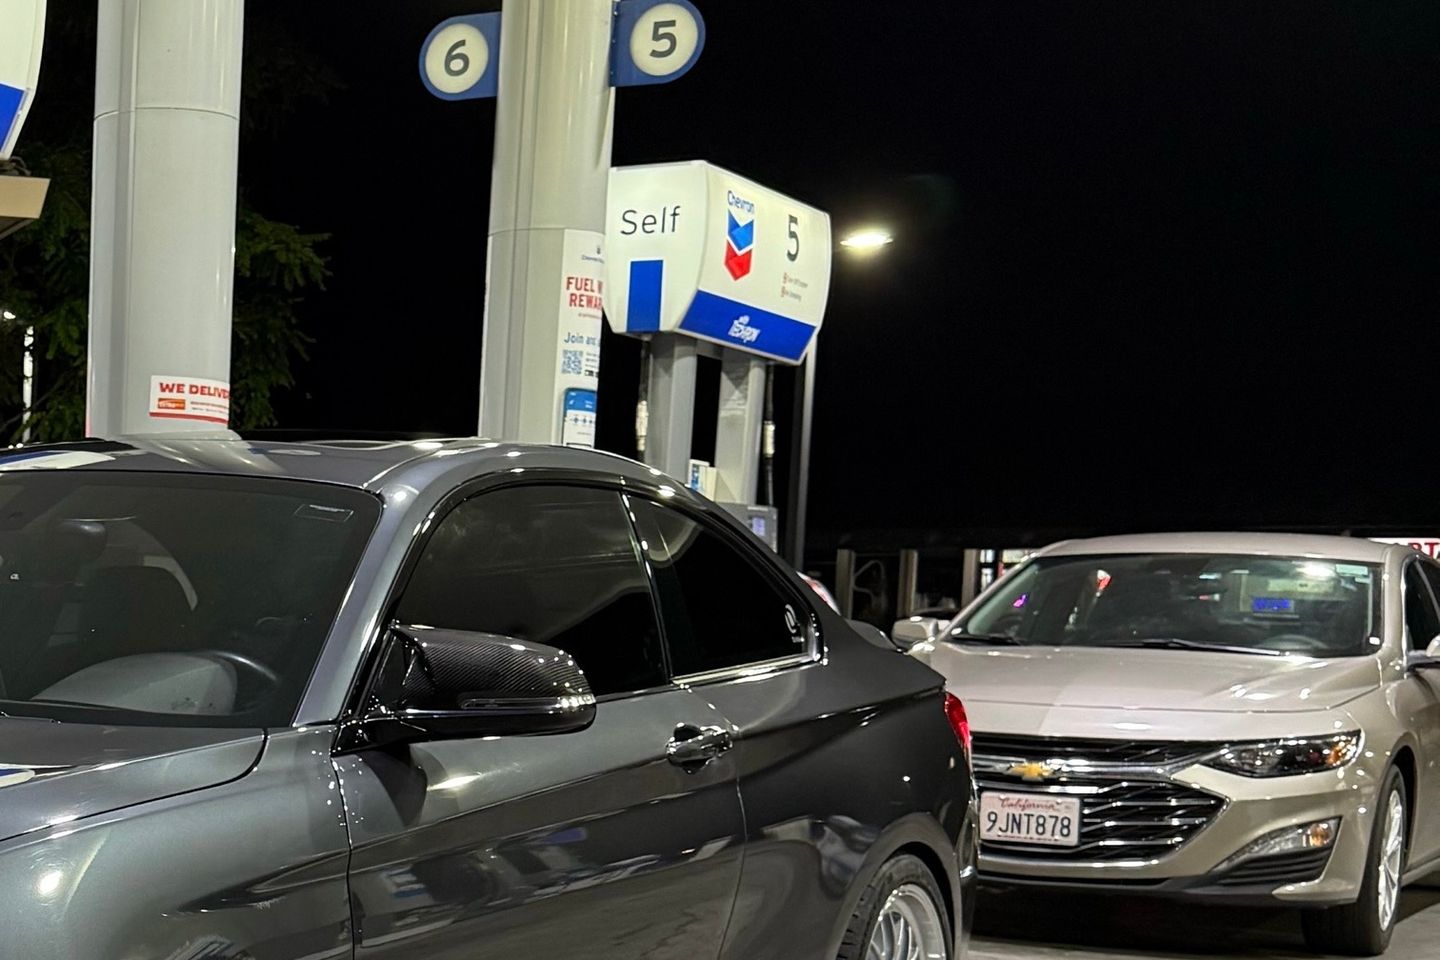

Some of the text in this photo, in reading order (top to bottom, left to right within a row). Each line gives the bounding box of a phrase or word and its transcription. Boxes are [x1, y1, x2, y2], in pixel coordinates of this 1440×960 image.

[649, 20, 677, 59] 5
[444, 39, 470, 76] 6
[727, 190, 754, 212] Chevron
[620, 206, 681, 235] Self
[786, 214, 800, 262] 5
[566, 277, 595, 293] FUEL
[564, 332, 584, 344] Join
[159, 383, 185, 393] WE
[1000, 798, 1055, 811] California
[986, 811, 1071, 838] 9JNT878
